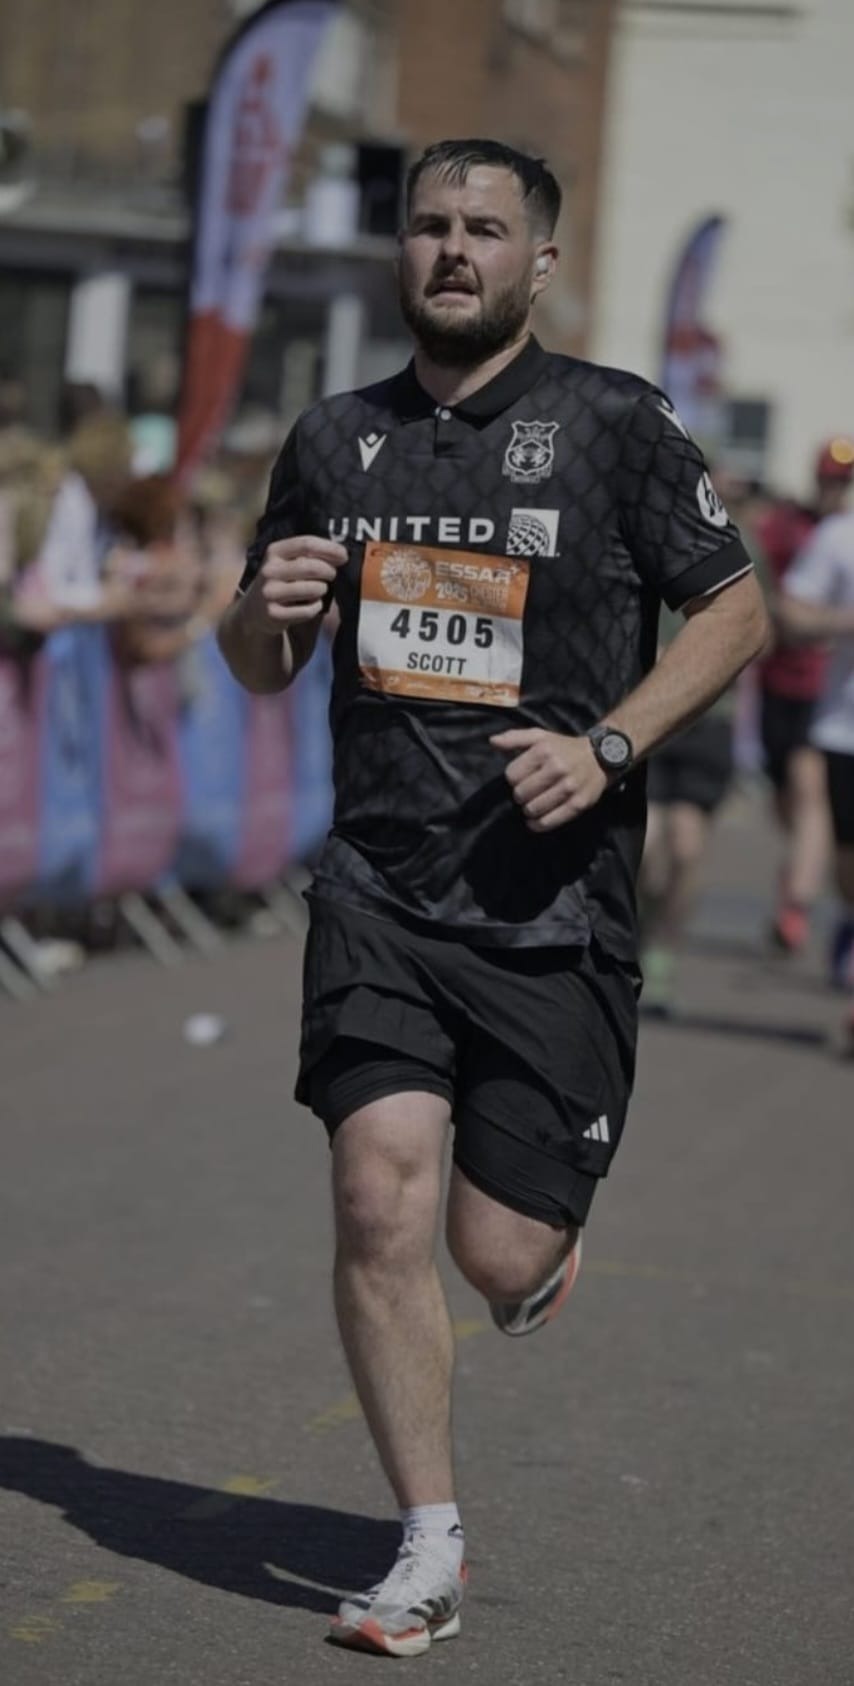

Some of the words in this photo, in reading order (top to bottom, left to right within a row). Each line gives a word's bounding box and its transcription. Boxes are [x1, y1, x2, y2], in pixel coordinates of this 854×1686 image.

[328, 516, 496, 543] UNITED
[434, 561, 512, 586] ESSAR
[390, 608, 494, 649] 4505
[406, 651, 467, 675] SCOTT
